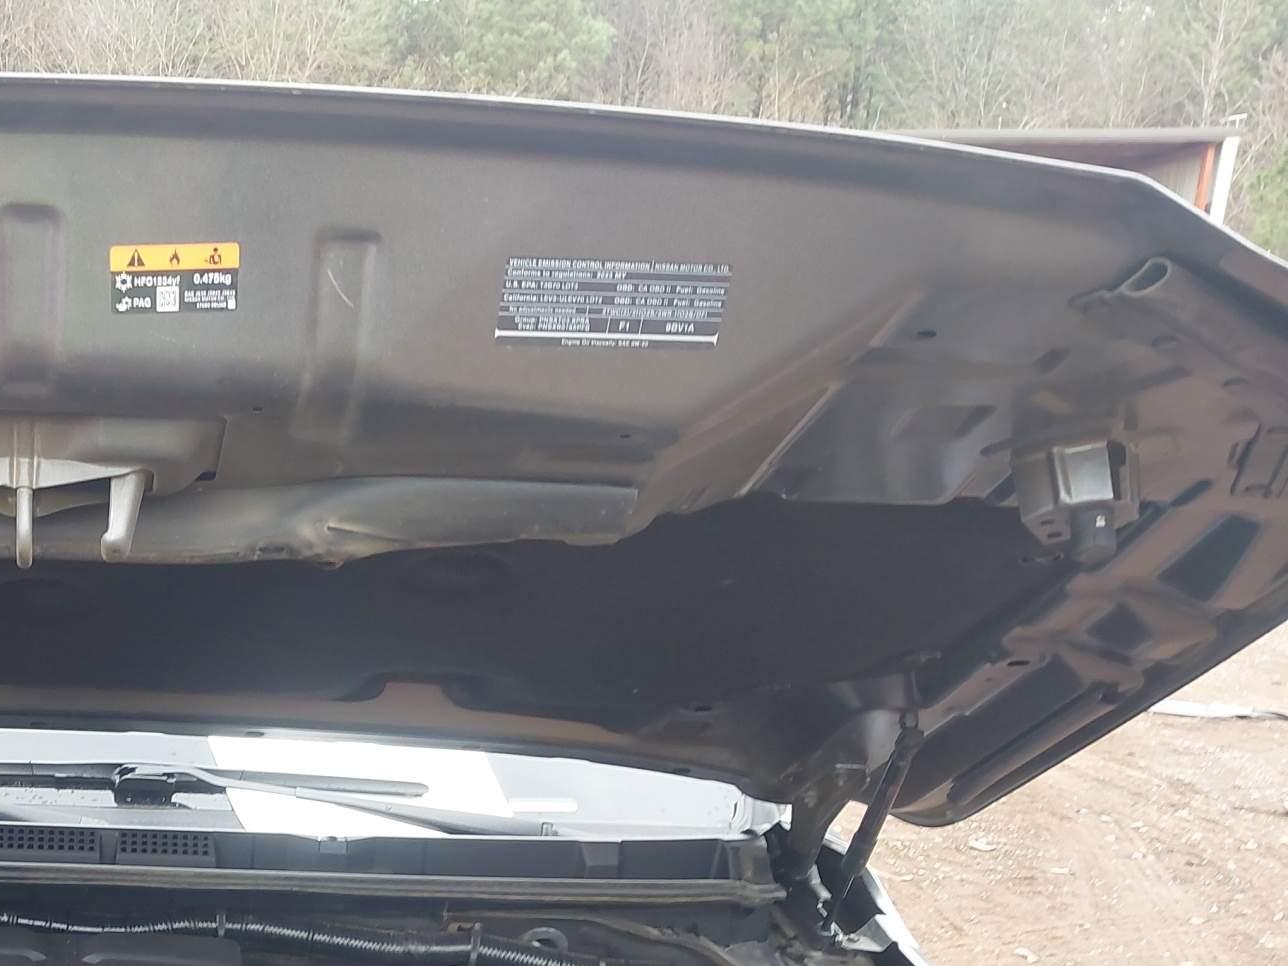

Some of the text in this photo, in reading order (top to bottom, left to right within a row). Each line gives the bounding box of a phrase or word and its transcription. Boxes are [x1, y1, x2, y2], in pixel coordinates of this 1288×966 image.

[509, 257, 537, 267] VEHICLE
[537, 258, 571, 269] EMISSION
[572, 259, 602, 270] CONTROL
[603, 261, 651, 271] INFORMATION
